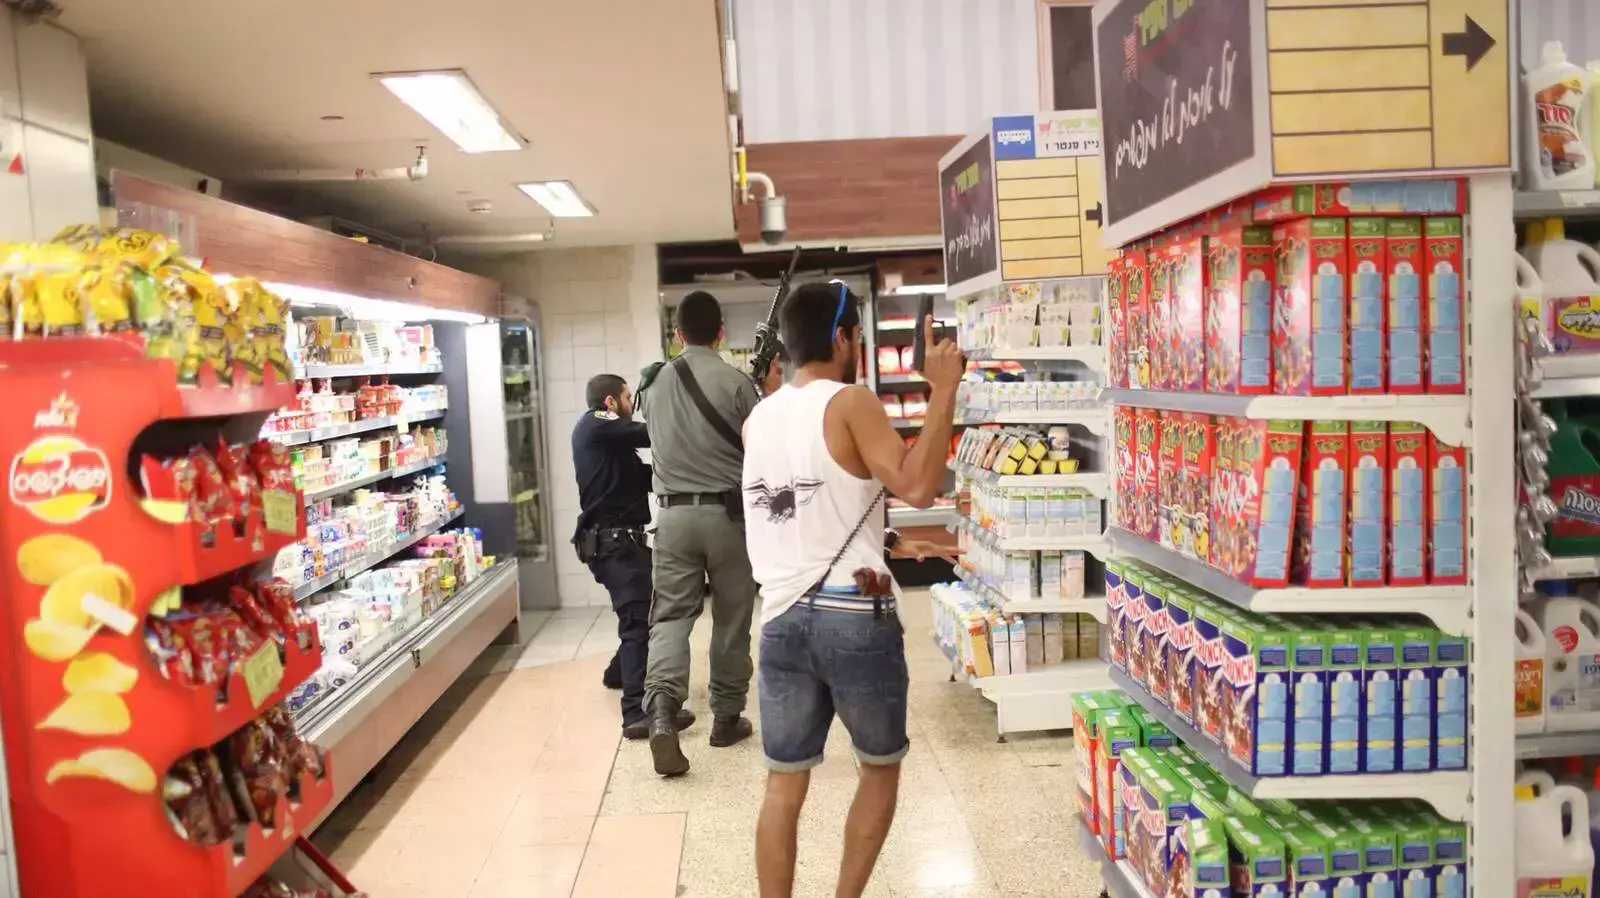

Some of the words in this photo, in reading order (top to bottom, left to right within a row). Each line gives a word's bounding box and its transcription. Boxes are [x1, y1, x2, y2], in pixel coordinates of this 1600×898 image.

[1162, 76, 1178, 148] לא
[1176, 66, 1214, 144] איכות
[1115, 114, 1158, 178] מתפשרים
